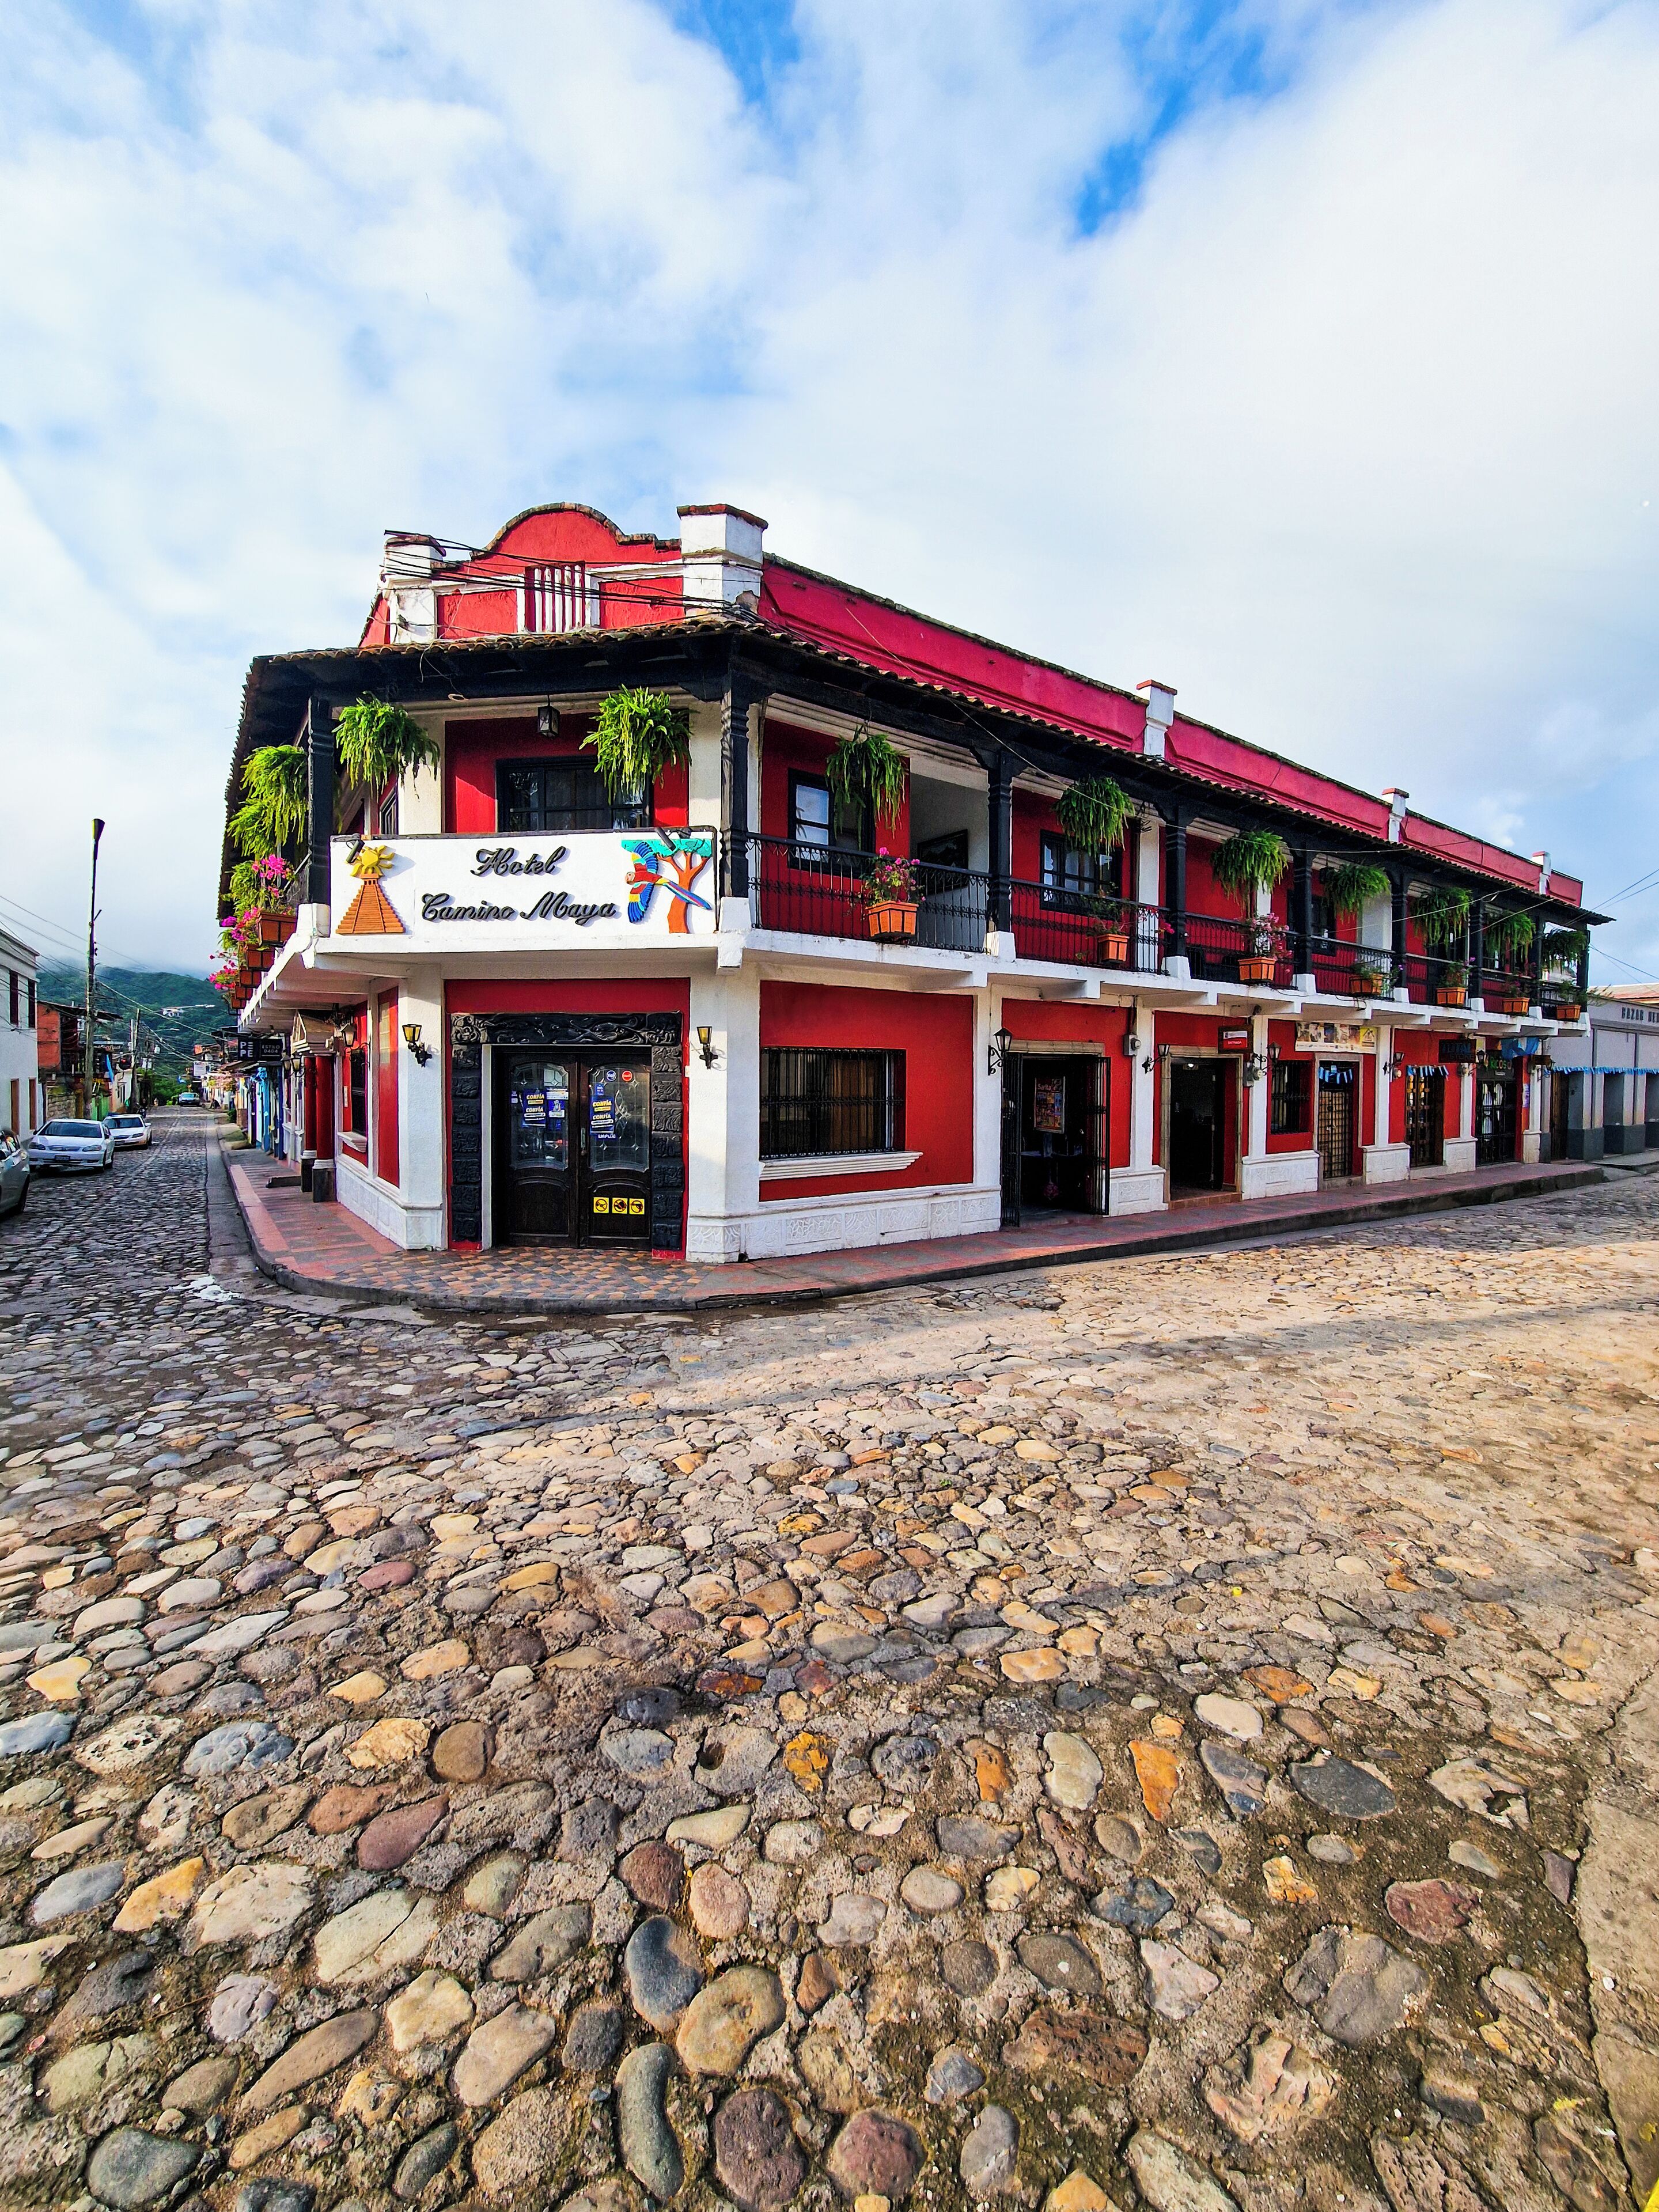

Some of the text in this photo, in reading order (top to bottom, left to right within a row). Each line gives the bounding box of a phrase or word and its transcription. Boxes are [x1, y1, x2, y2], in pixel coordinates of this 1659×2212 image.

[470, 846, 567, 877] Hotel
[421, 891, 618, 926] Camino Maya
[1622, 1006, 1643, 1020] BAZAR
